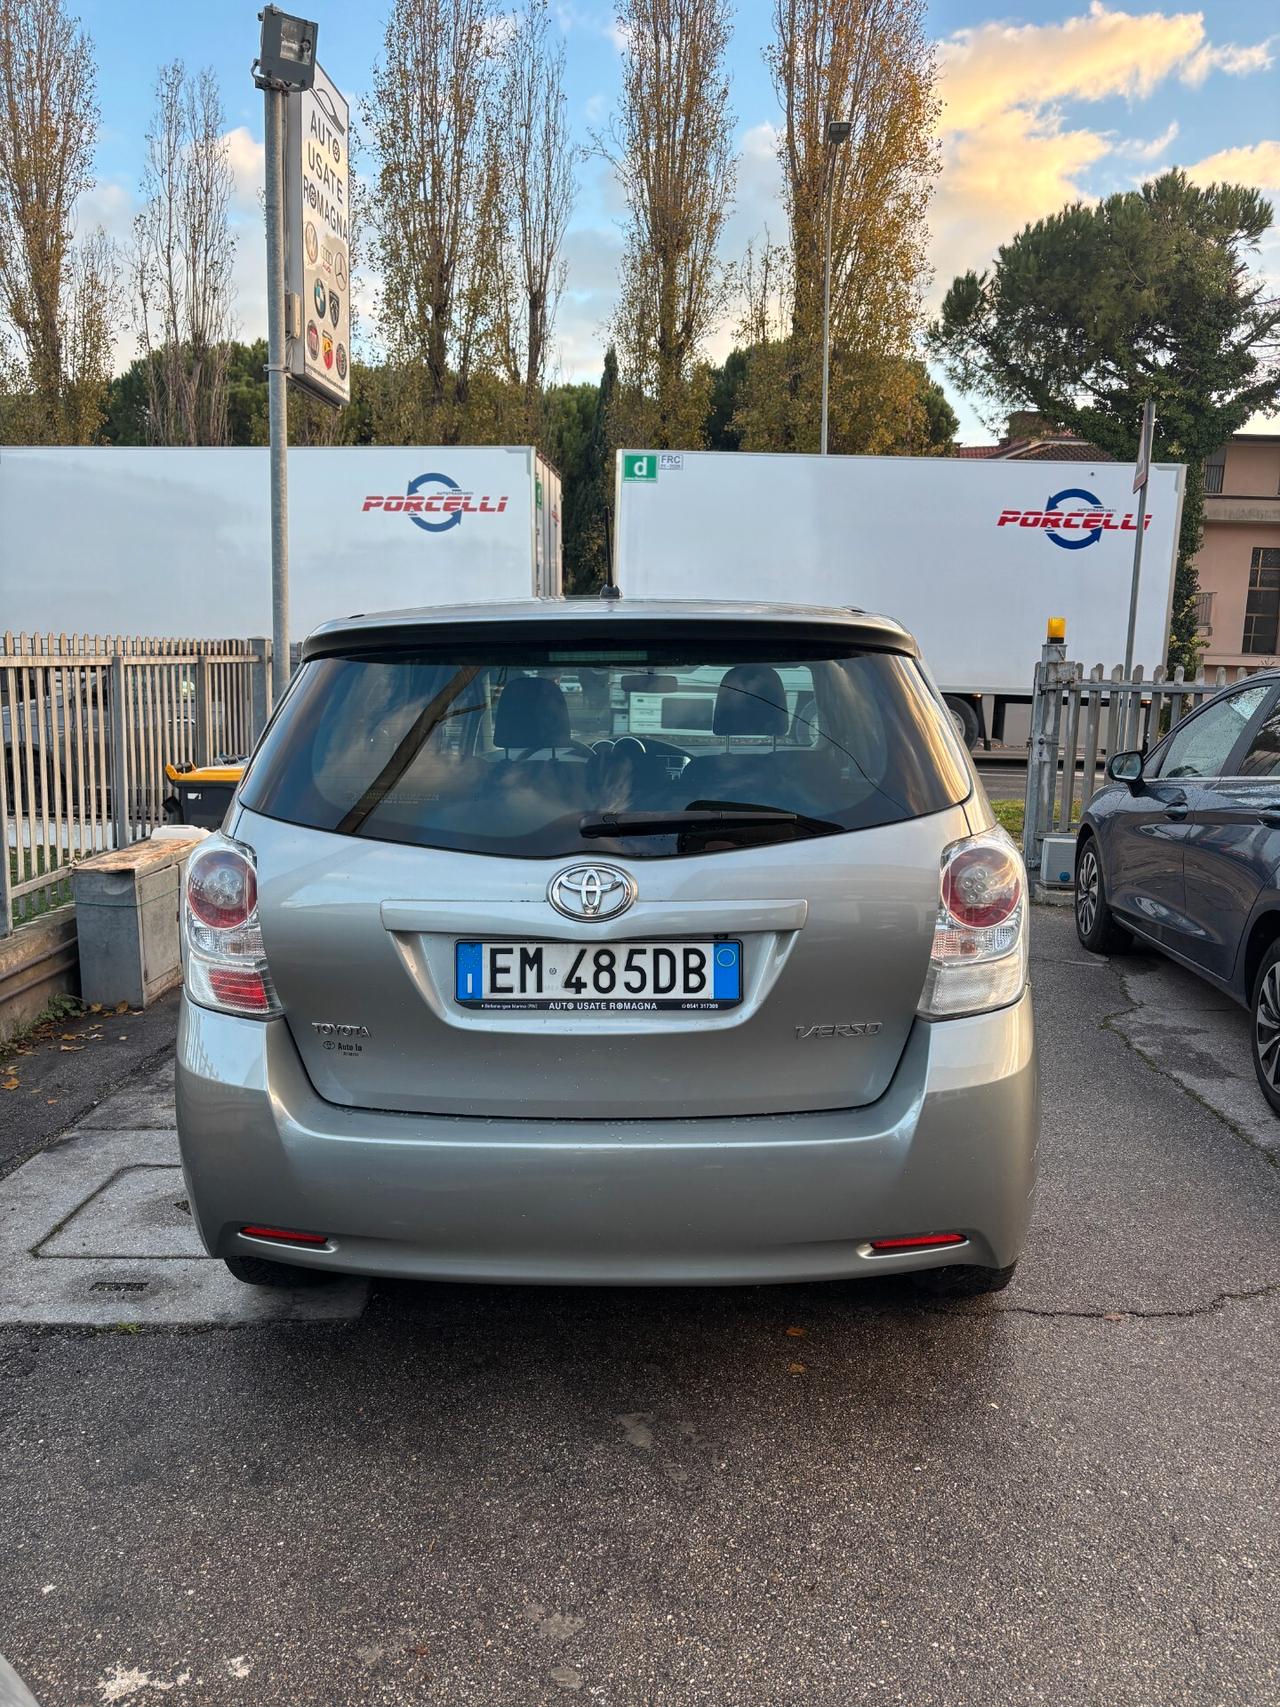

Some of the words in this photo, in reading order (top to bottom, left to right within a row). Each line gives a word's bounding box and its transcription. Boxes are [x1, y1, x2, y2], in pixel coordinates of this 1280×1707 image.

[310, 110, 340, 164] AUTO
[308, 141, 343, 205] USATE
[303, 174, 349, 246] ROMAGNA
[633, 456, 648, 476] d
[660, 455, 681, 464] FRC
[362, 495, 509, 513] PORCELLI
[997, 510, 1153, 531] PORCELLI
[489, 947, 544, 994] EM
[563, 948, 707, 995] 485DB
[548, 1002, 575, 1010] AUTO
[576, 1002, 607, 1010] USATE
[609, 1002, 658, 1010] ROMAGNA
[311, 1022, 372, 1039] TOYOTA
[795, 1022, 883, 1040] VERSO
